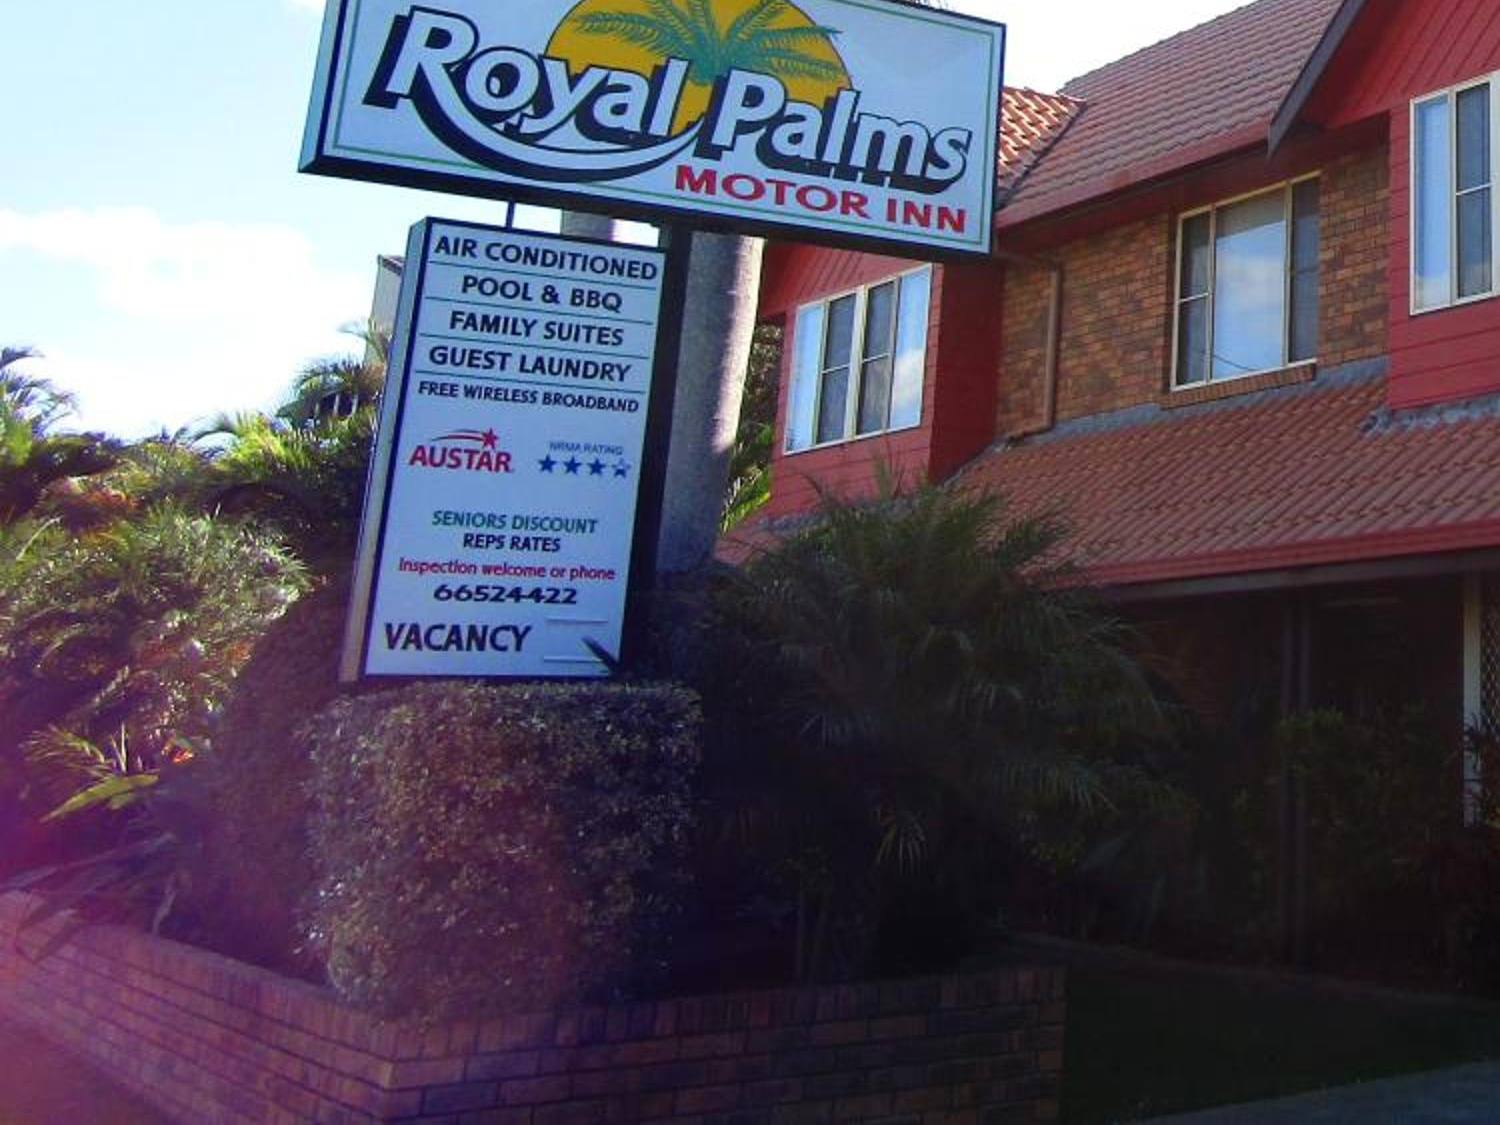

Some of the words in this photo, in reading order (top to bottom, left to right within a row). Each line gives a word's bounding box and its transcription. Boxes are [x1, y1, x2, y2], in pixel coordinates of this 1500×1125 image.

[362, 5, 705, 183] Royal
[706, 67, 972, 195] Palms
[675, 165, 867, 218] MOTOR
[886, 200, 967, 234] INN
[434, 236, 477, 258] AIR
[485, 242, 657, 280] CONDITIONED
[461, 275, 532, 301] POOL
[541, 284, 560, 304] &
[570, 288, 622, 313] BBQ
[449, 311, 538, 337] FAMILY
[543, 321, 624, 346] SUITES
[429, 345, 511, 371] GUEST
[519, 354, 632, 383] LAUNDRY
[418, 381, 458, 398] FREE
[463, 385, 538, 405] WIRELESS
[542, 392, 639, 413] BROADBAND
[409, 445, 513, 472] AUSTAR
[584, 443, 624, 455] RATING
[432, 510, 507, 529] SENIORS
[511, 516, 598, 534] DISCOUNT
[463, 533, 505, 549] REPS
[509, 536, 561, 552] RATES
[399, 557, 477, 575] Inspection
[481, 561, 546, 578] welcome
[549, 567, 566, 579] or
[568, 563, 616, 581] phone
[433, 584, 577, 605] 66524422
[384, 623, 532, 652] VACANCY
